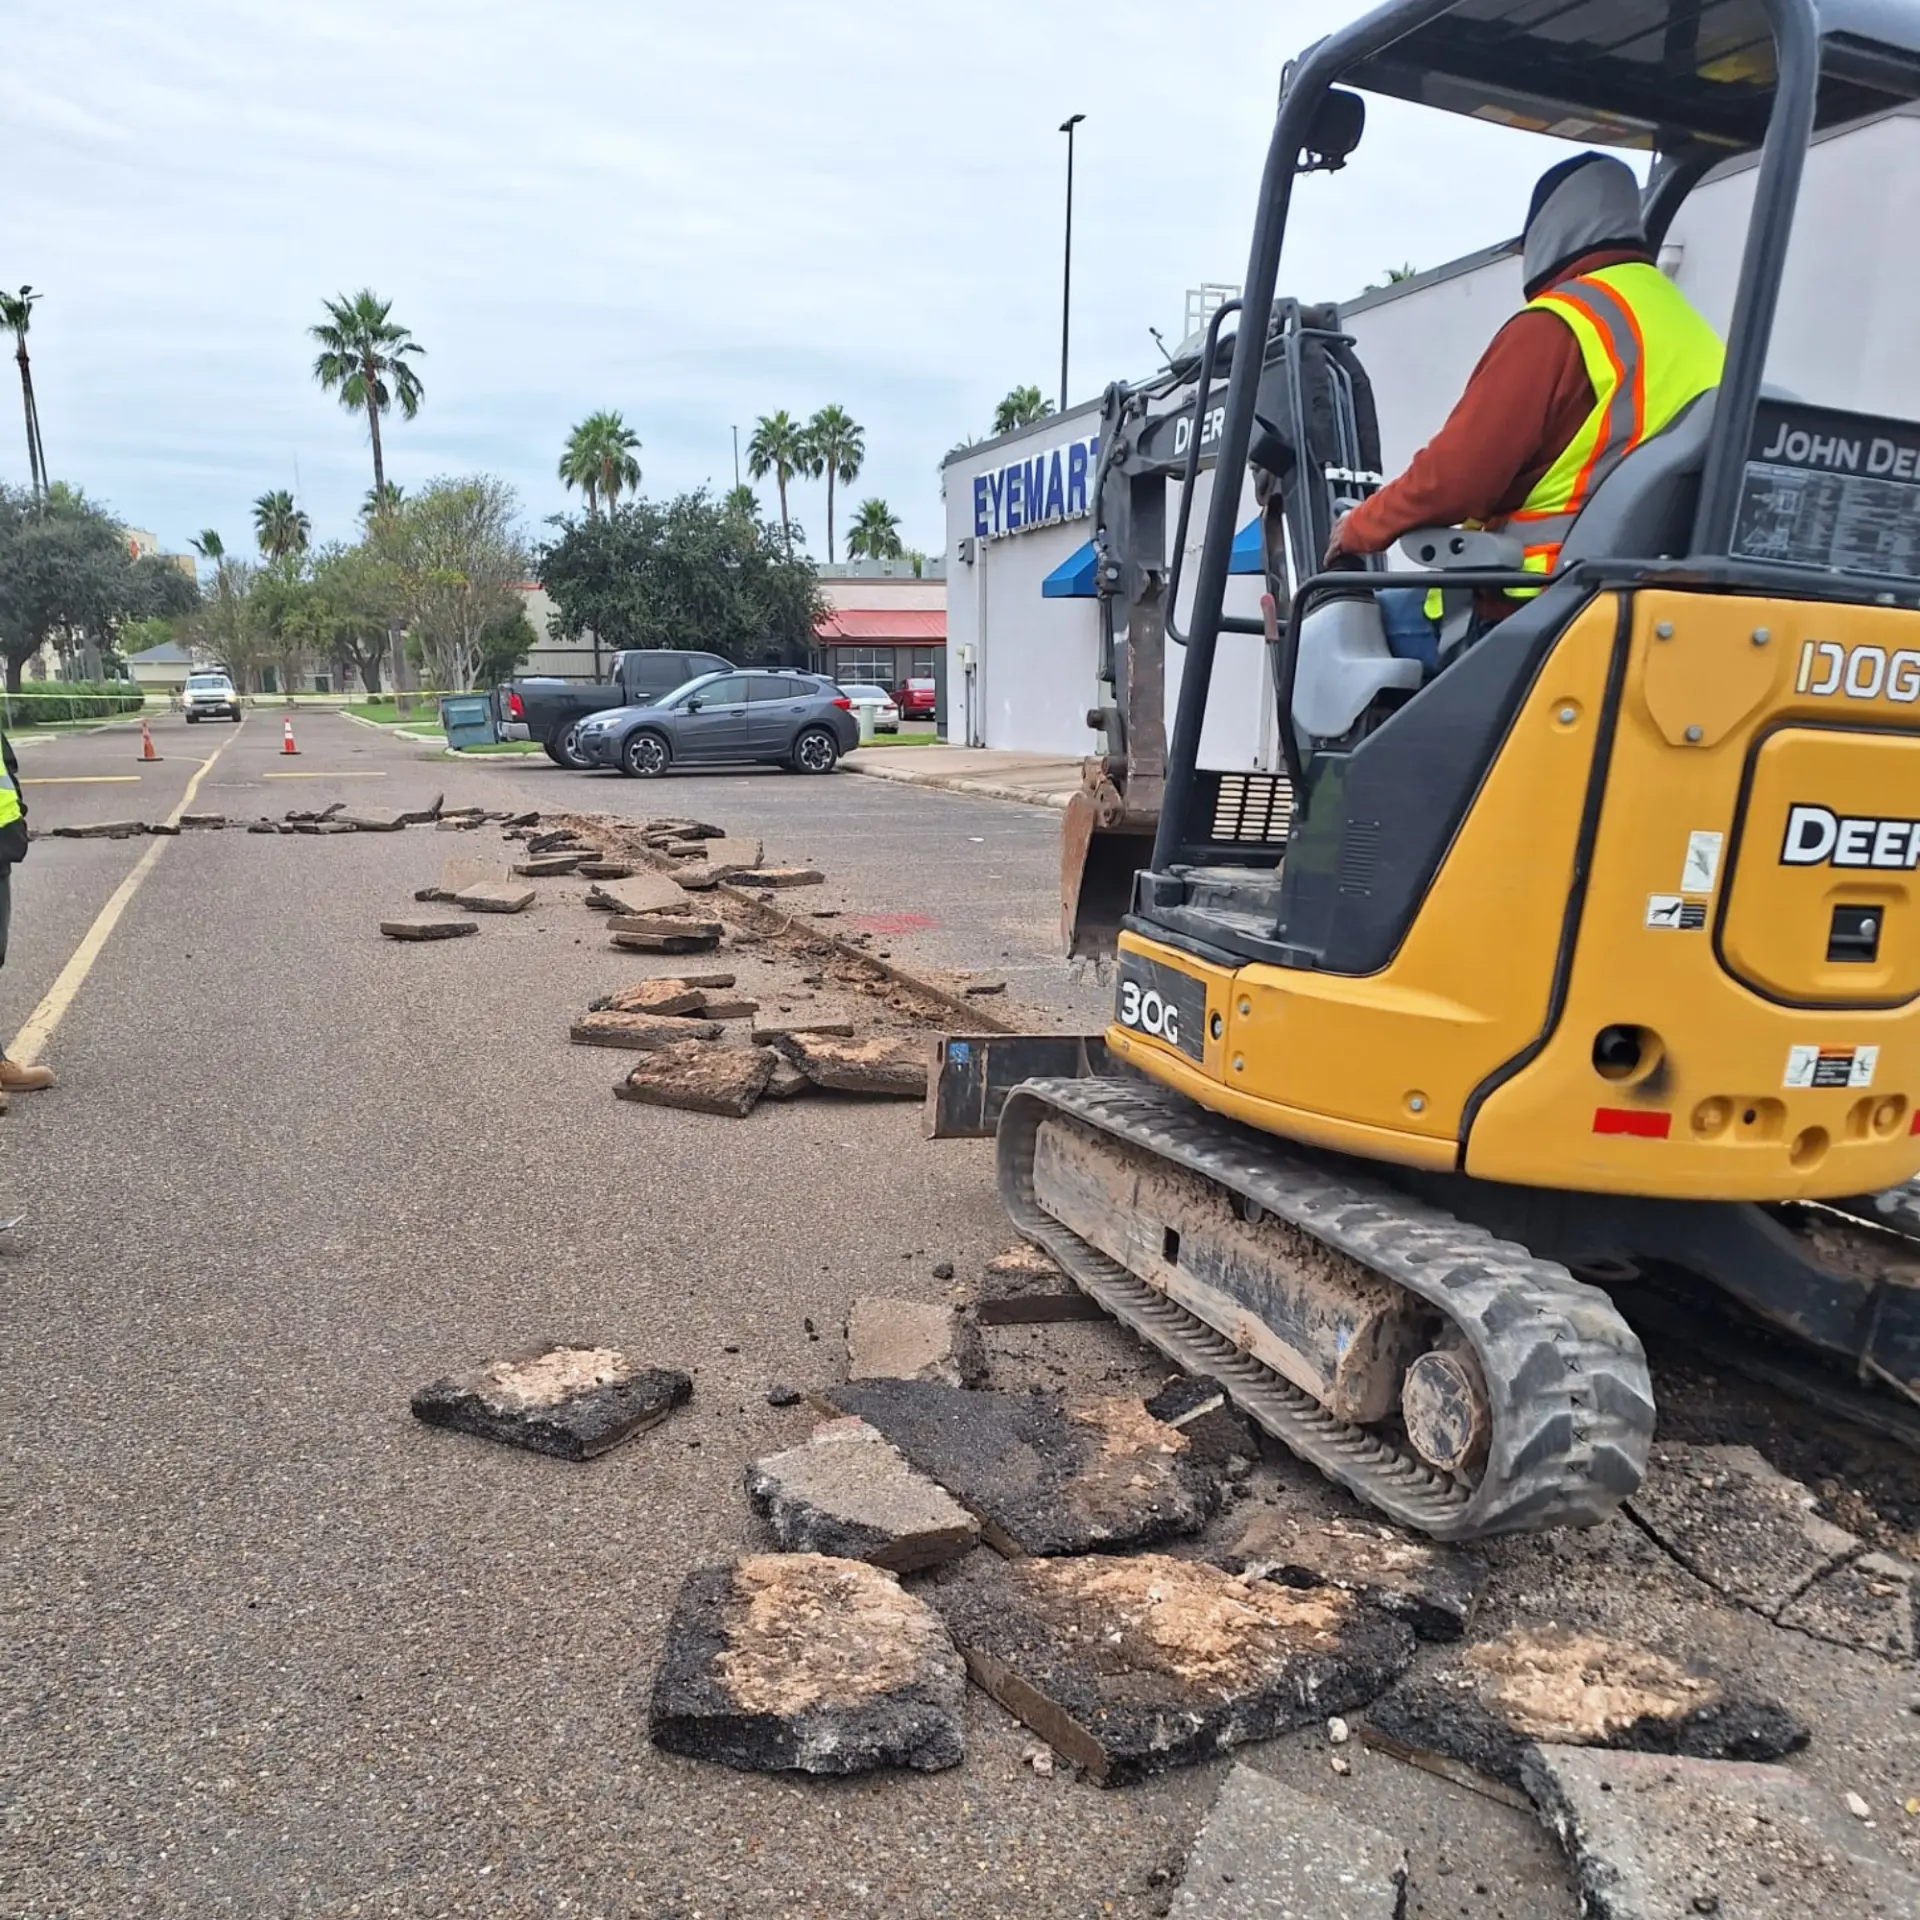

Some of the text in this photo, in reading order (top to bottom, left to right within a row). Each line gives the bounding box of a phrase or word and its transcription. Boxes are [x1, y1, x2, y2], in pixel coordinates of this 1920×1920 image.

[1762, 422, 1920, 481] JOHN DE
[1121, 980, 1179, 1045] 30G
